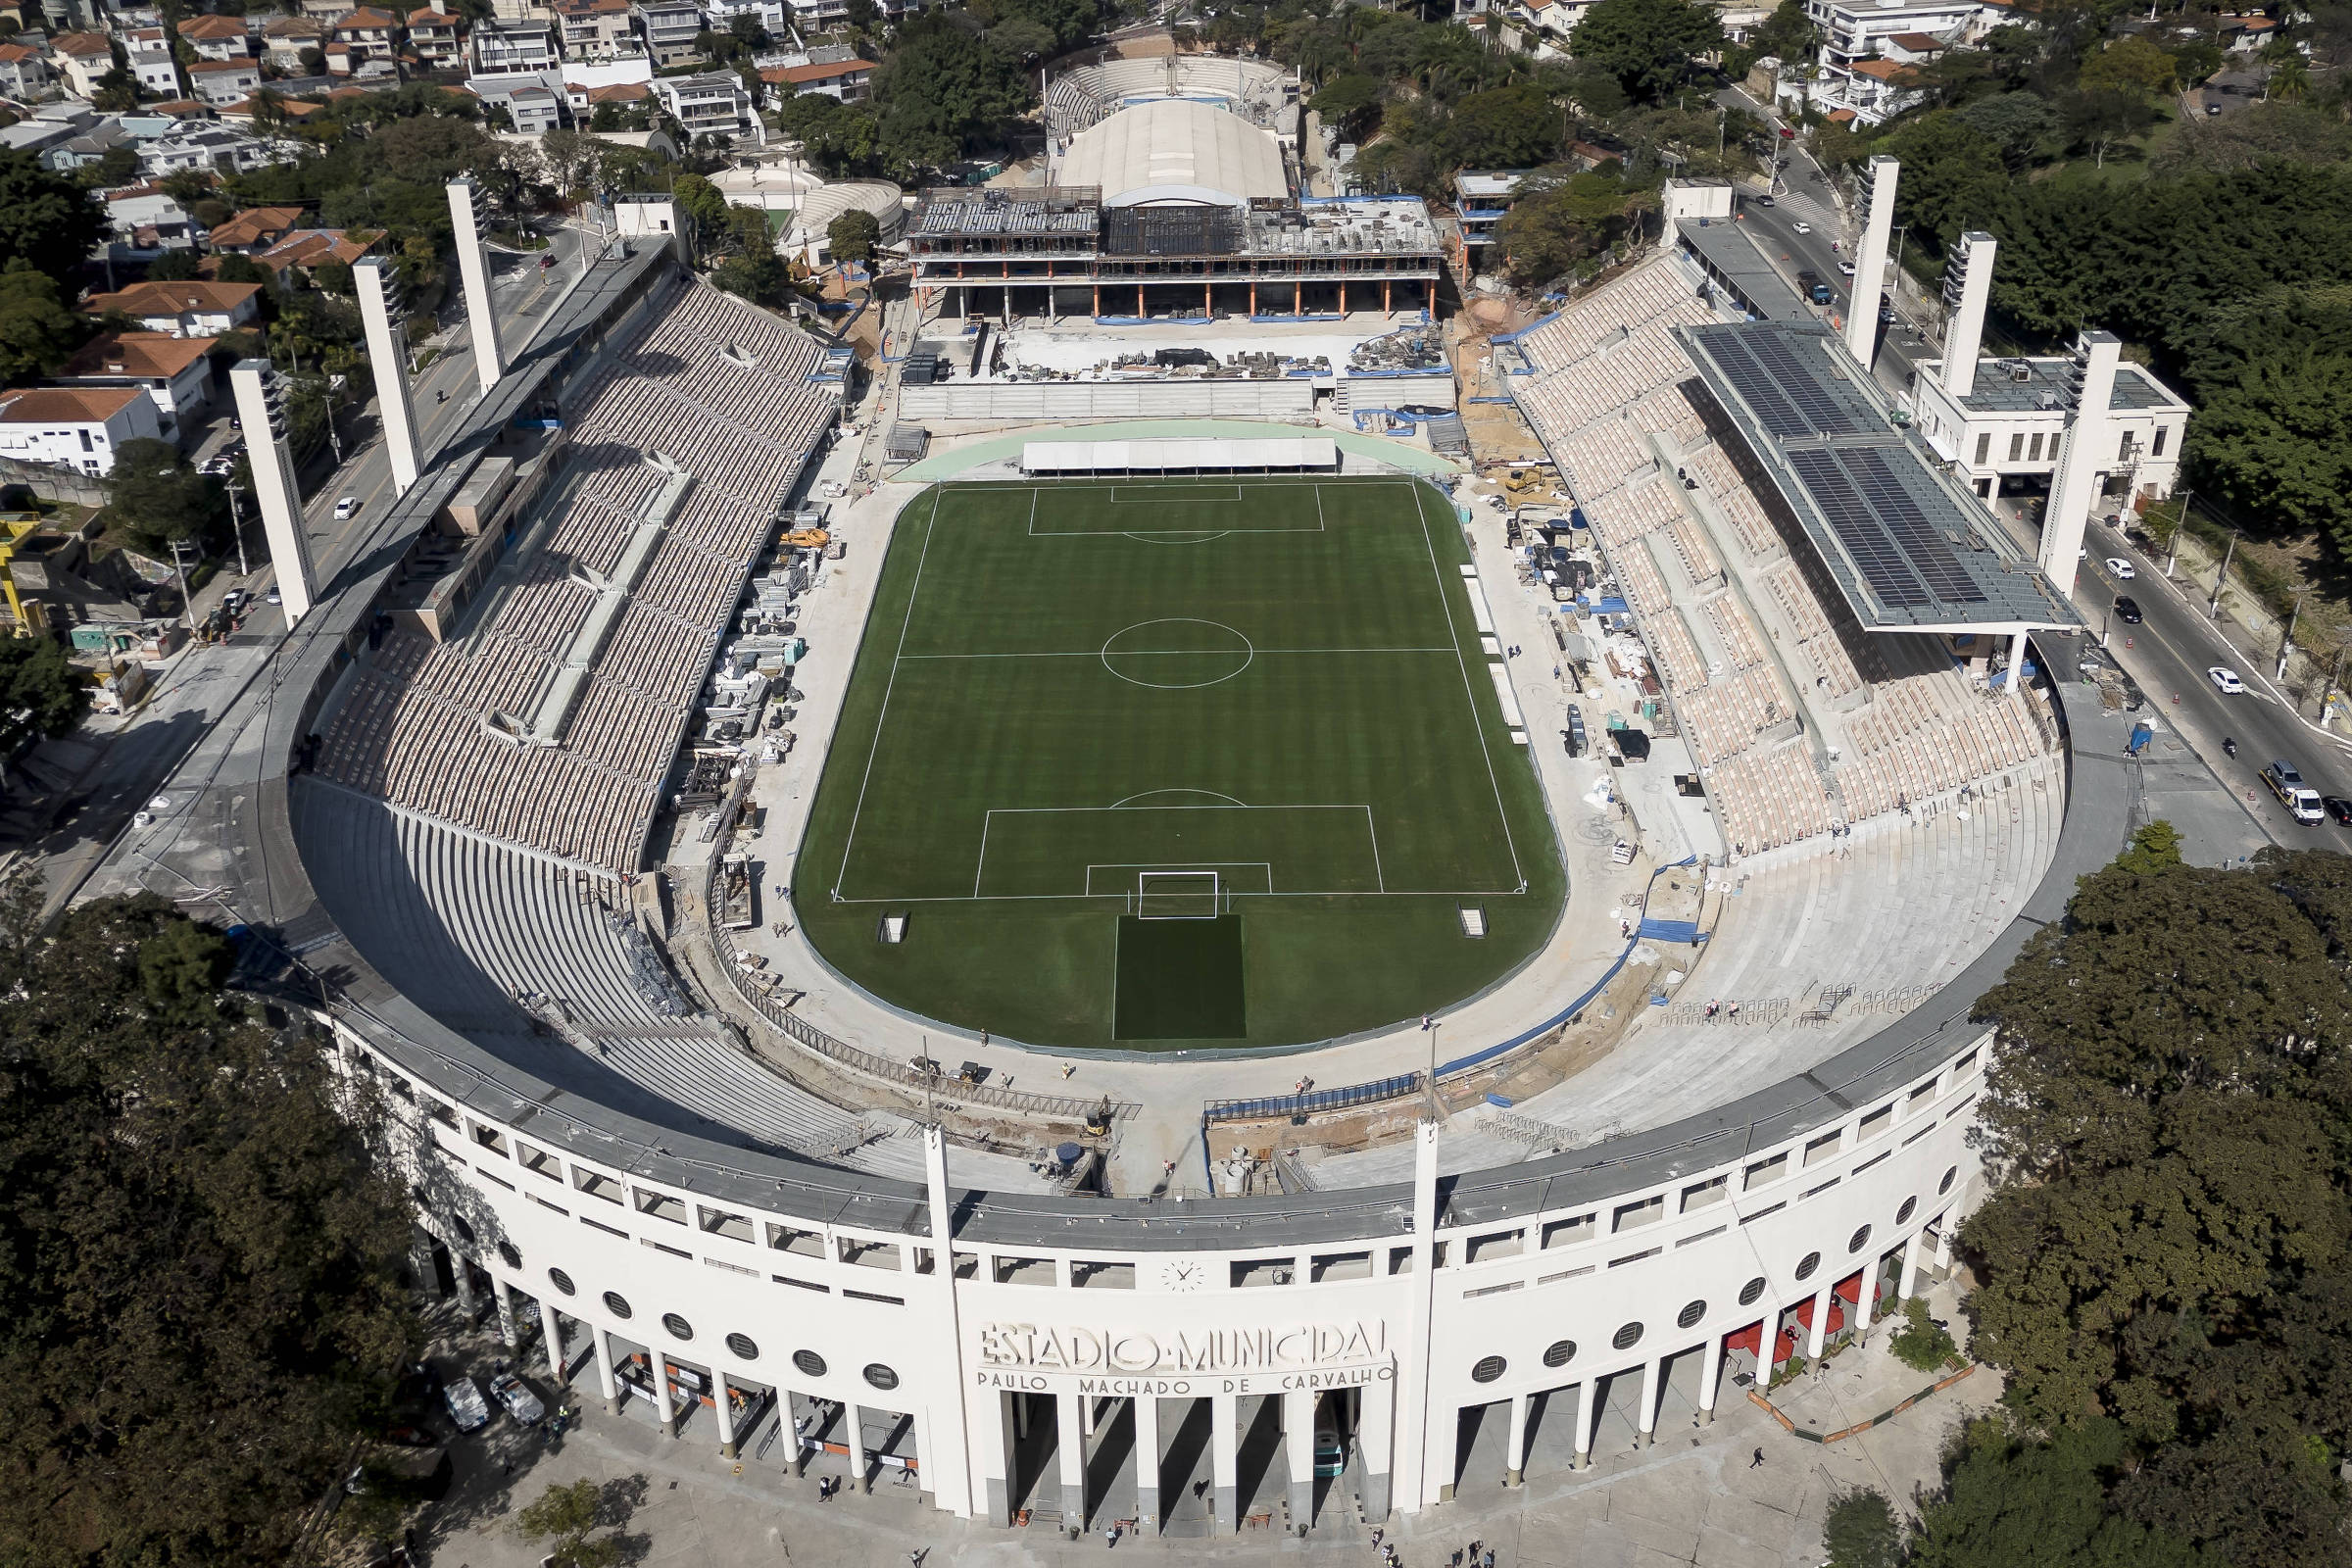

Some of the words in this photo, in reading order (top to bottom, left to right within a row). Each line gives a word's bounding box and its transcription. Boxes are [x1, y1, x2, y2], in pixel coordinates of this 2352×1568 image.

[980, 1322, 1161, 1372] ESTADIO
[1177, 1318, 1394, 1371] MUNICIPAL
[977, 1371, 1048, 1391] PAULO
[1079, 1378, 1191, 1395] MACHADO
[1223, 1378, 1250, 1394] DE
[1282, 1366, 1396, 1390] CARVALHO
